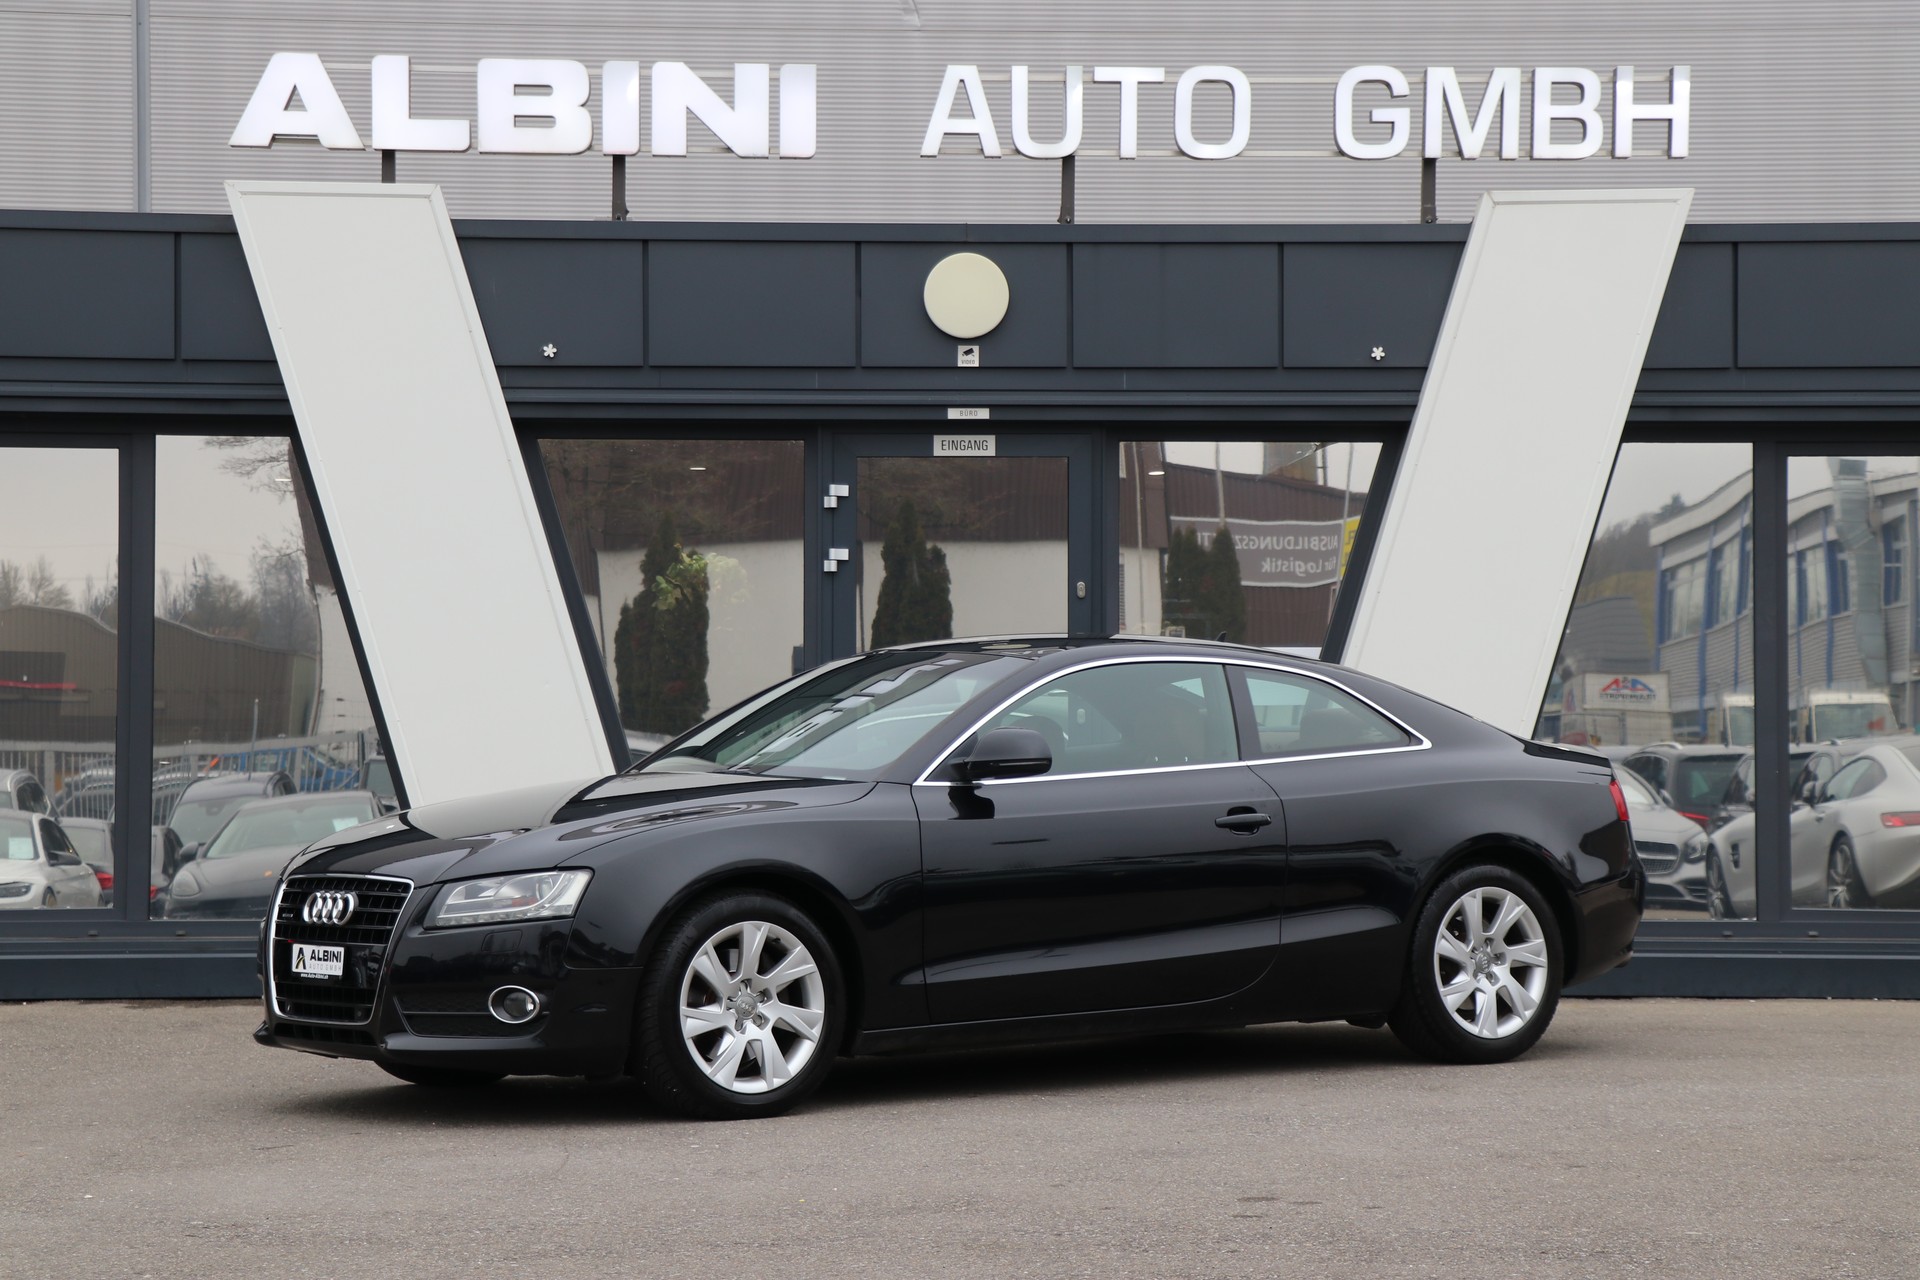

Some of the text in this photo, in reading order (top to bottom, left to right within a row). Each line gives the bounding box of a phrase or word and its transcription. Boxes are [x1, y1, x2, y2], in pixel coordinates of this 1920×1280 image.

[228, 51, 1691, 160] ALBINI AUTO GMBH
[941, 439, 989, 451] EINGANG
[309, 949, 342, 963] ALBINI
